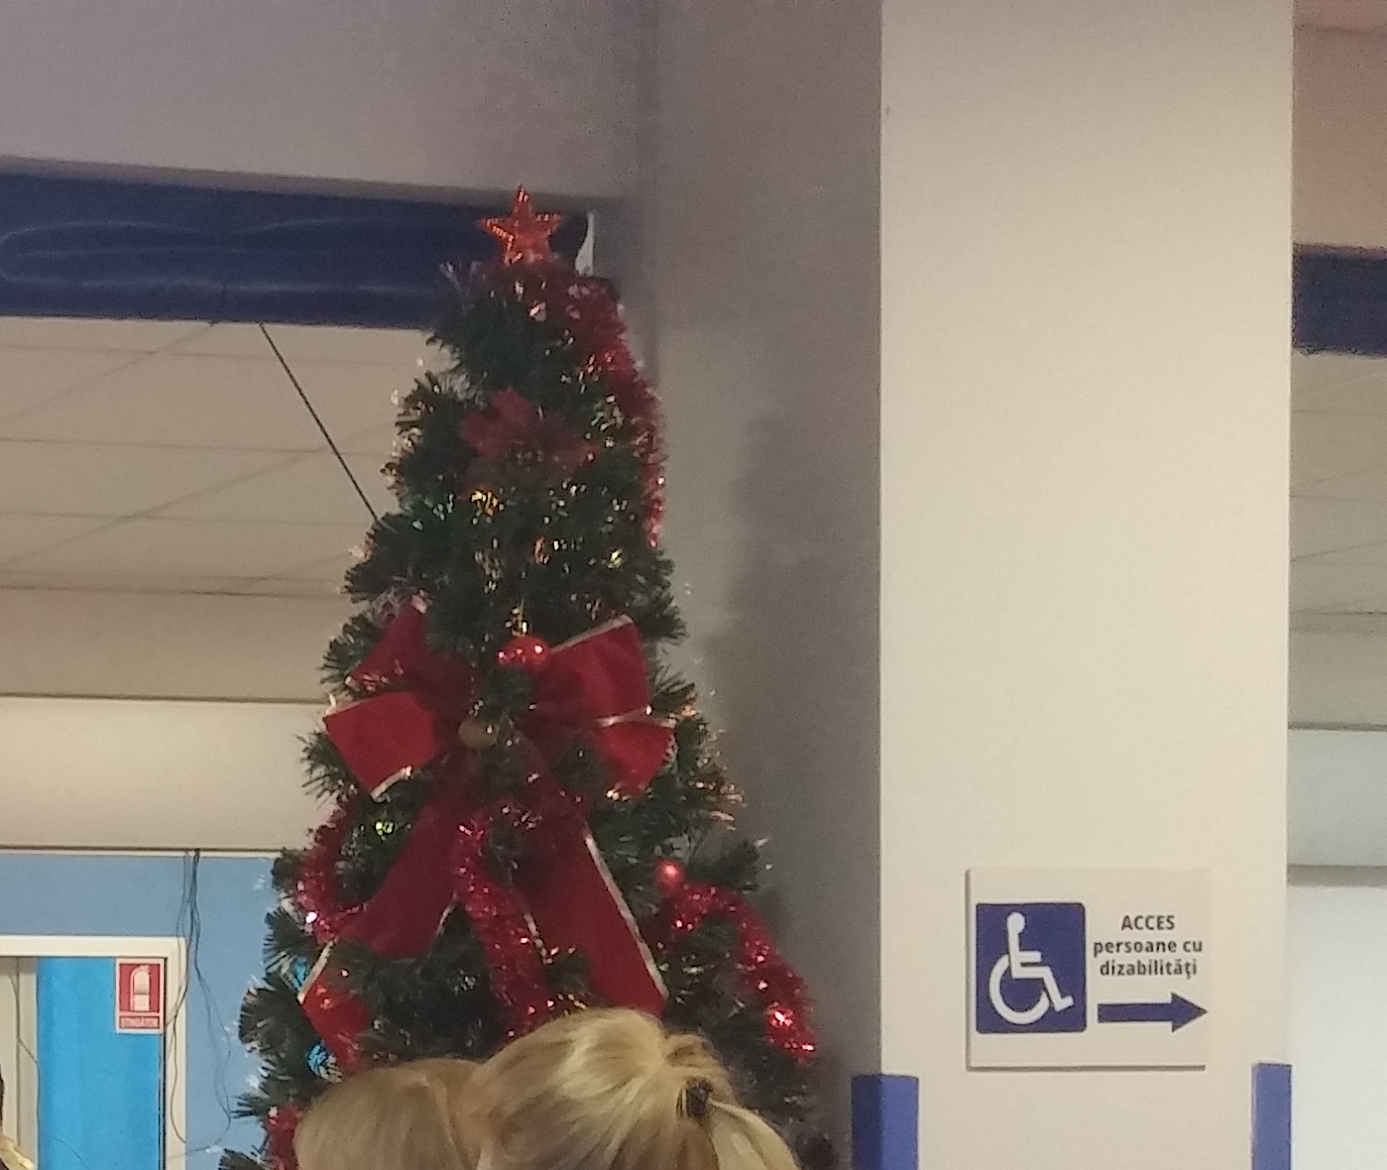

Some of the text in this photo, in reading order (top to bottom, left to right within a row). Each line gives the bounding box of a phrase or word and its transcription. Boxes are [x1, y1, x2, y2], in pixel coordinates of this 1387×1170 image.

[1121, 915, 1175, 931] ACCES
[1093, 940, 1203, 959] persoane cu
